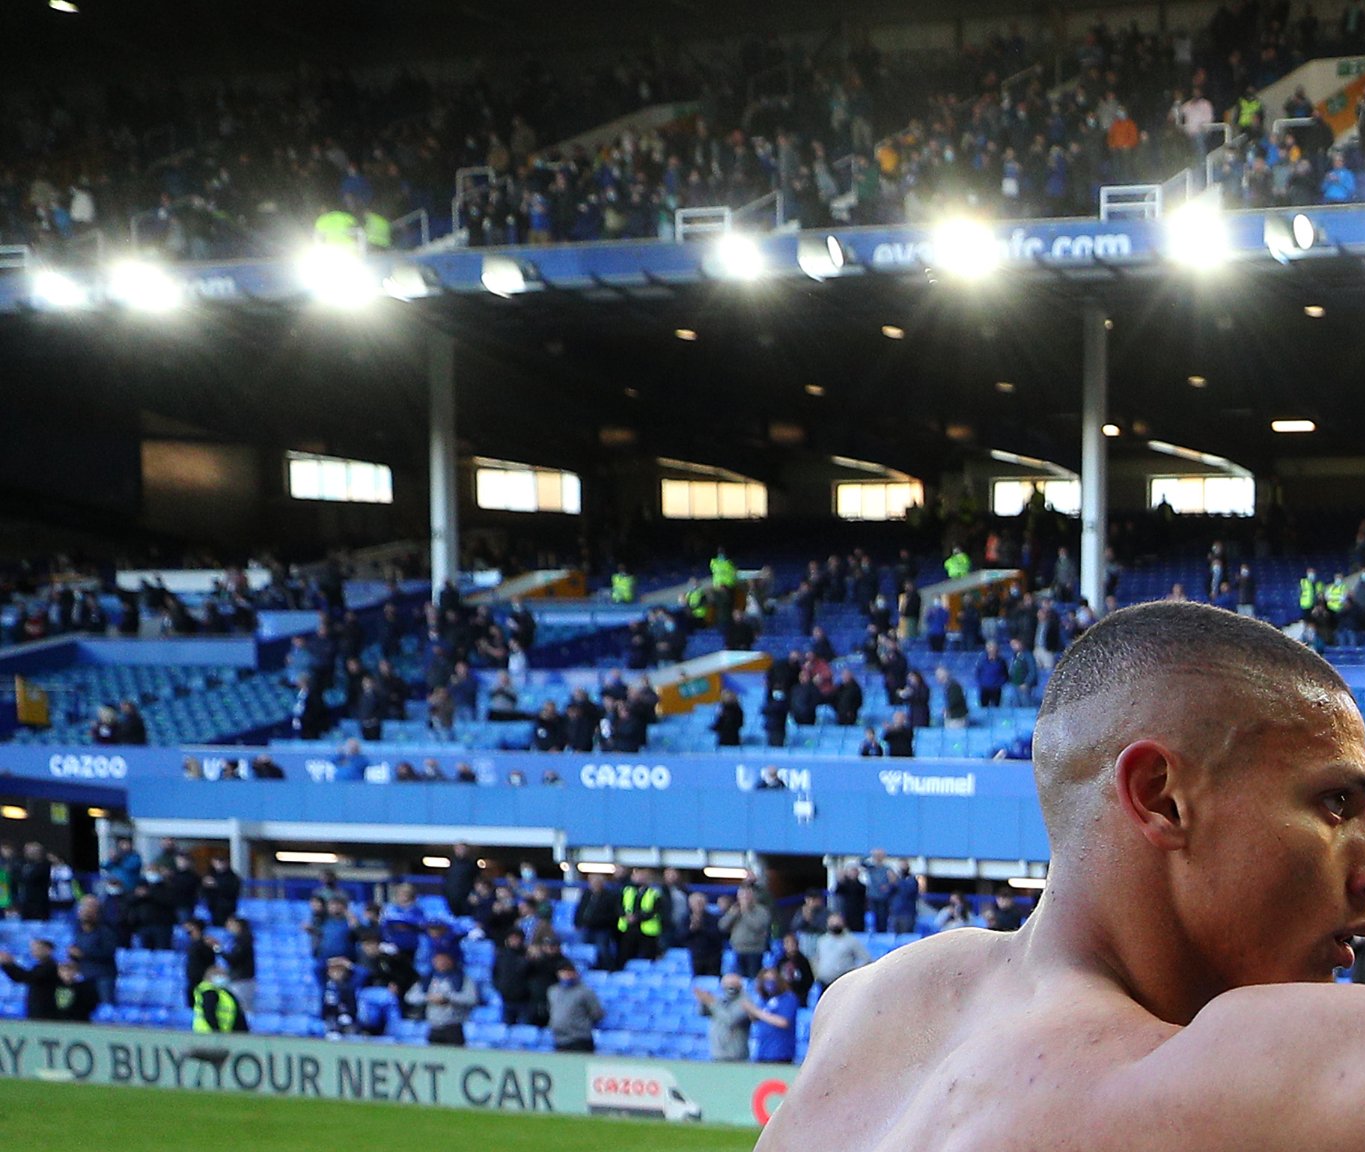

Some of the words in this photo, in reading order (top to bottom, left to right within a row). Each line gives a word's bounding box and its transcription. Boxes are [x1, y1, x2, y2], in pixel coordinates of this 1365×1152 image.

[50, 754, 128, 779] CAZOO
[580, 764, 672, 790] CAZOO
[902, 772, 975, 795] hummel
[0, 1037, 24, 1075] Y
[39, 1040, 94, 1079] TO
[109, 1043, 191, 1088] BUY
[337, 1056, 445, 1105] NEXT
[462, 1066, 553, 1112] CAR
